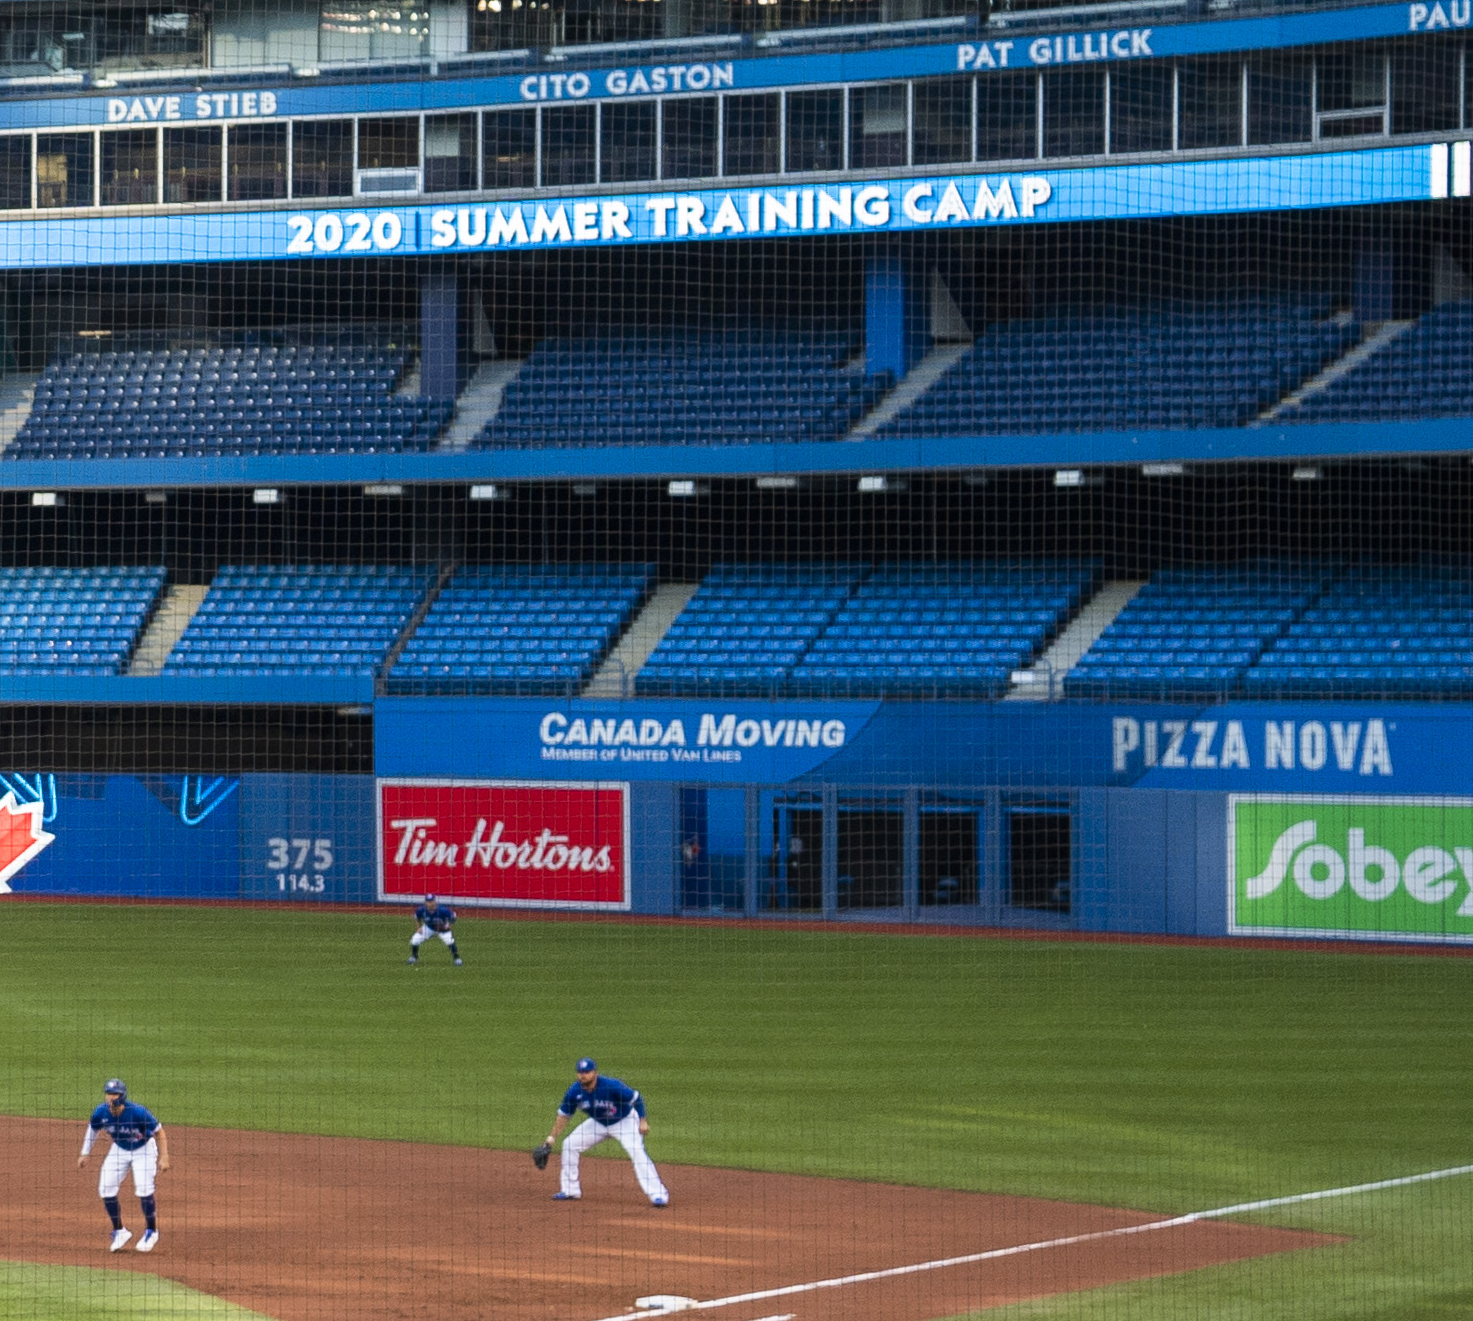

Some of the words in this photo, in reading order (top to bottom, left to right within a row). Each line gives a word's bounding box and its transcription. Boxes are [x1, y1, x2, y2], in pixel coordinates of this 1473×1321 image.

[957, 41, 1014, 71] PAT
[1030, 29, 1153, 65] GILLICK
[519, 72, 590, 101] CITO
[606, 63, 734, 95] GASTON
[108, 94, 182, 122] DAVE
[195, 91, 278, 117] STIEB
[286, 212, 403, 254] 2020
[430, 202, 630, 247] SUMMER
[645, 184, 889, 239] TRAINING
[903, 176, 1052, 225] CAMP
[1111, 715, 1250, 774] PIZZA
[1263, 717, 1394, 777] NOVA
[267, 837, 333, 872] 375
[390, 817, 459, 867] Tim
[463, 819, 613, 874] Hortons
[275, 873, 325, 894] 114.3
